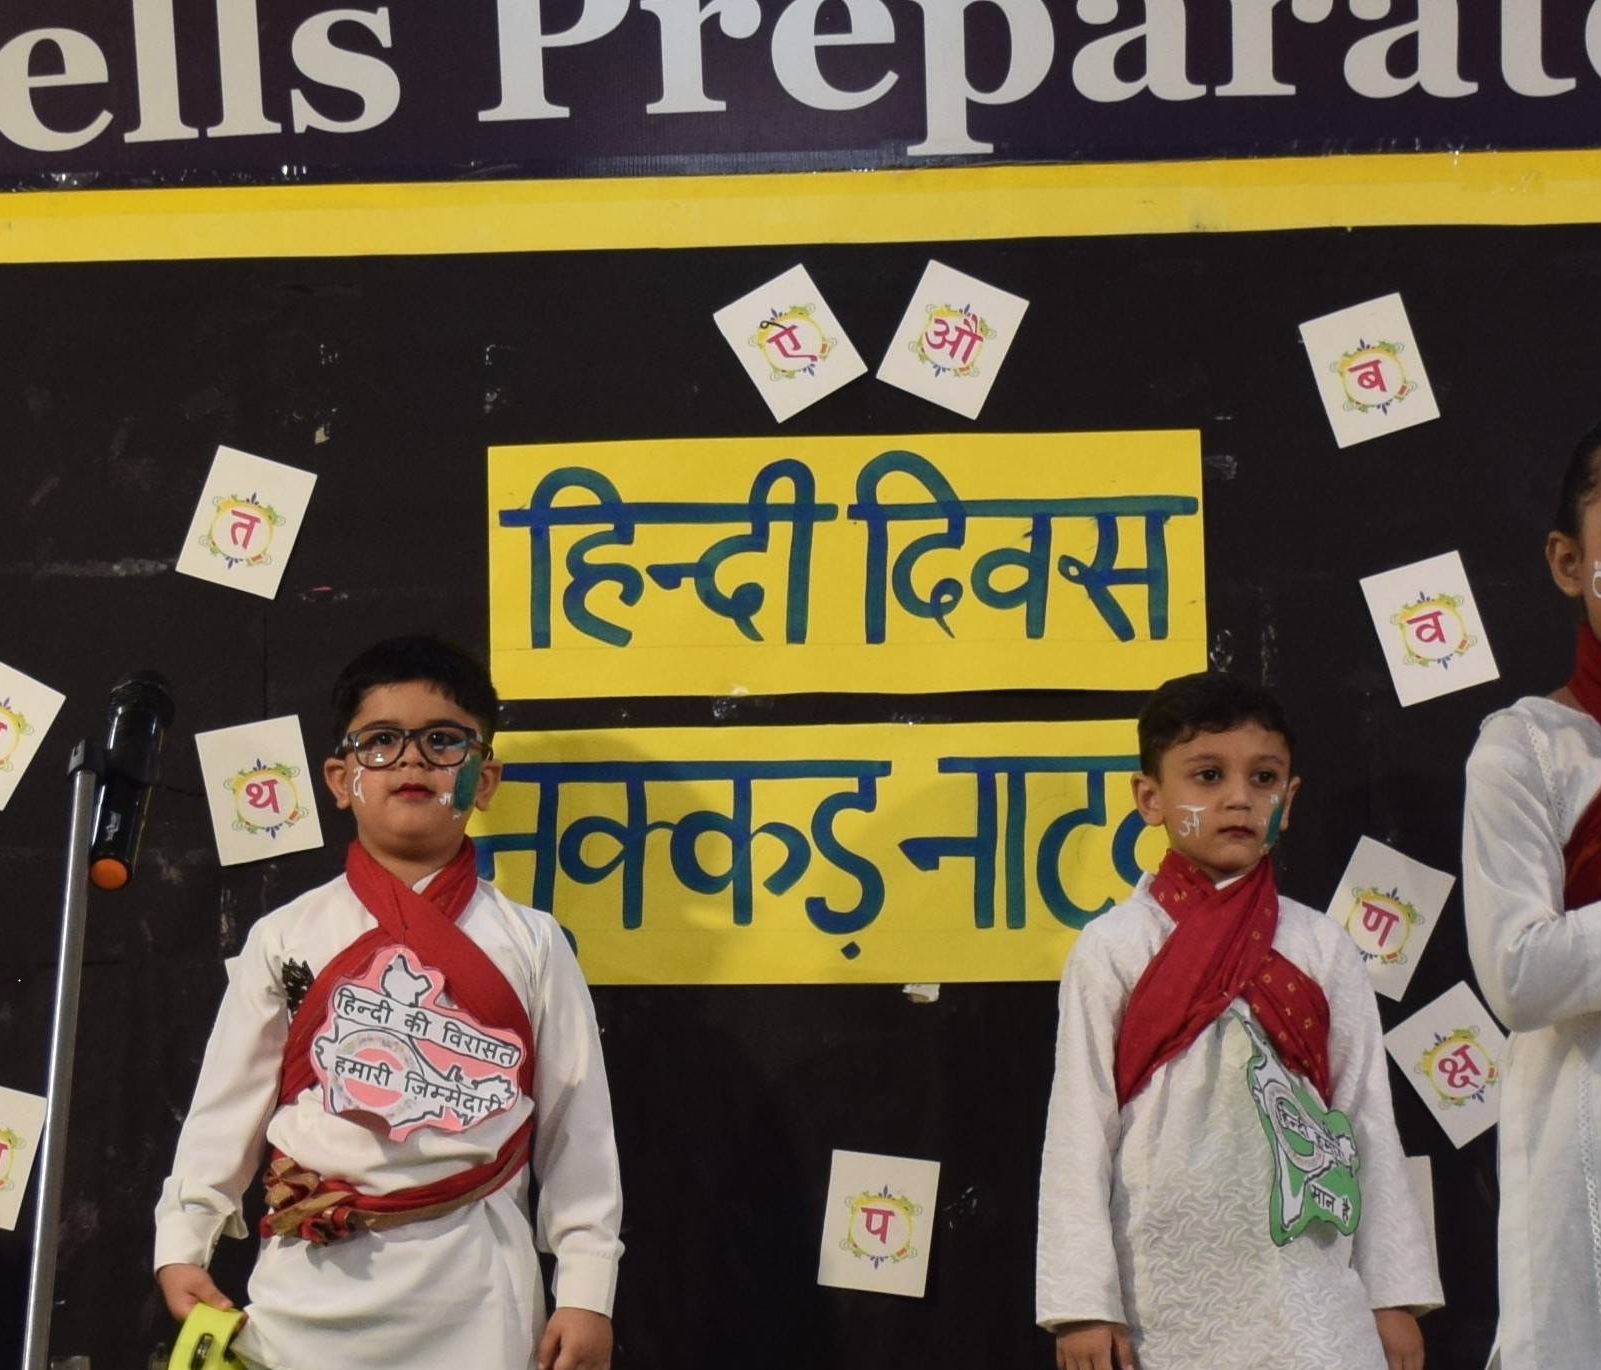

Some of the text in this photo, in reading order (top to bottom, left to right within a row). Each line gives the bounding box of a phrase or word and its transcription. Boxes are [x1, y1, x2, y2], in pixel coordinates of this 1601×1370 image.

[1348, 357, 1388, 392] ब
[228, 510, 261, 550] त
[499, 449, 1198, 649] हिन्दी दिवस
[1407, 609, 1447, 644] व
[244, 778, 281, 815] थ
[1360, 899, 1400, 950] ण
[337, 987, 521, 1066] हिन्दी की विरासत
[334, 1055, 394, 1087] हमारी
[1435, 1042, 1483, 1090] क्ष
[860, 1206, 896, 1245] प
